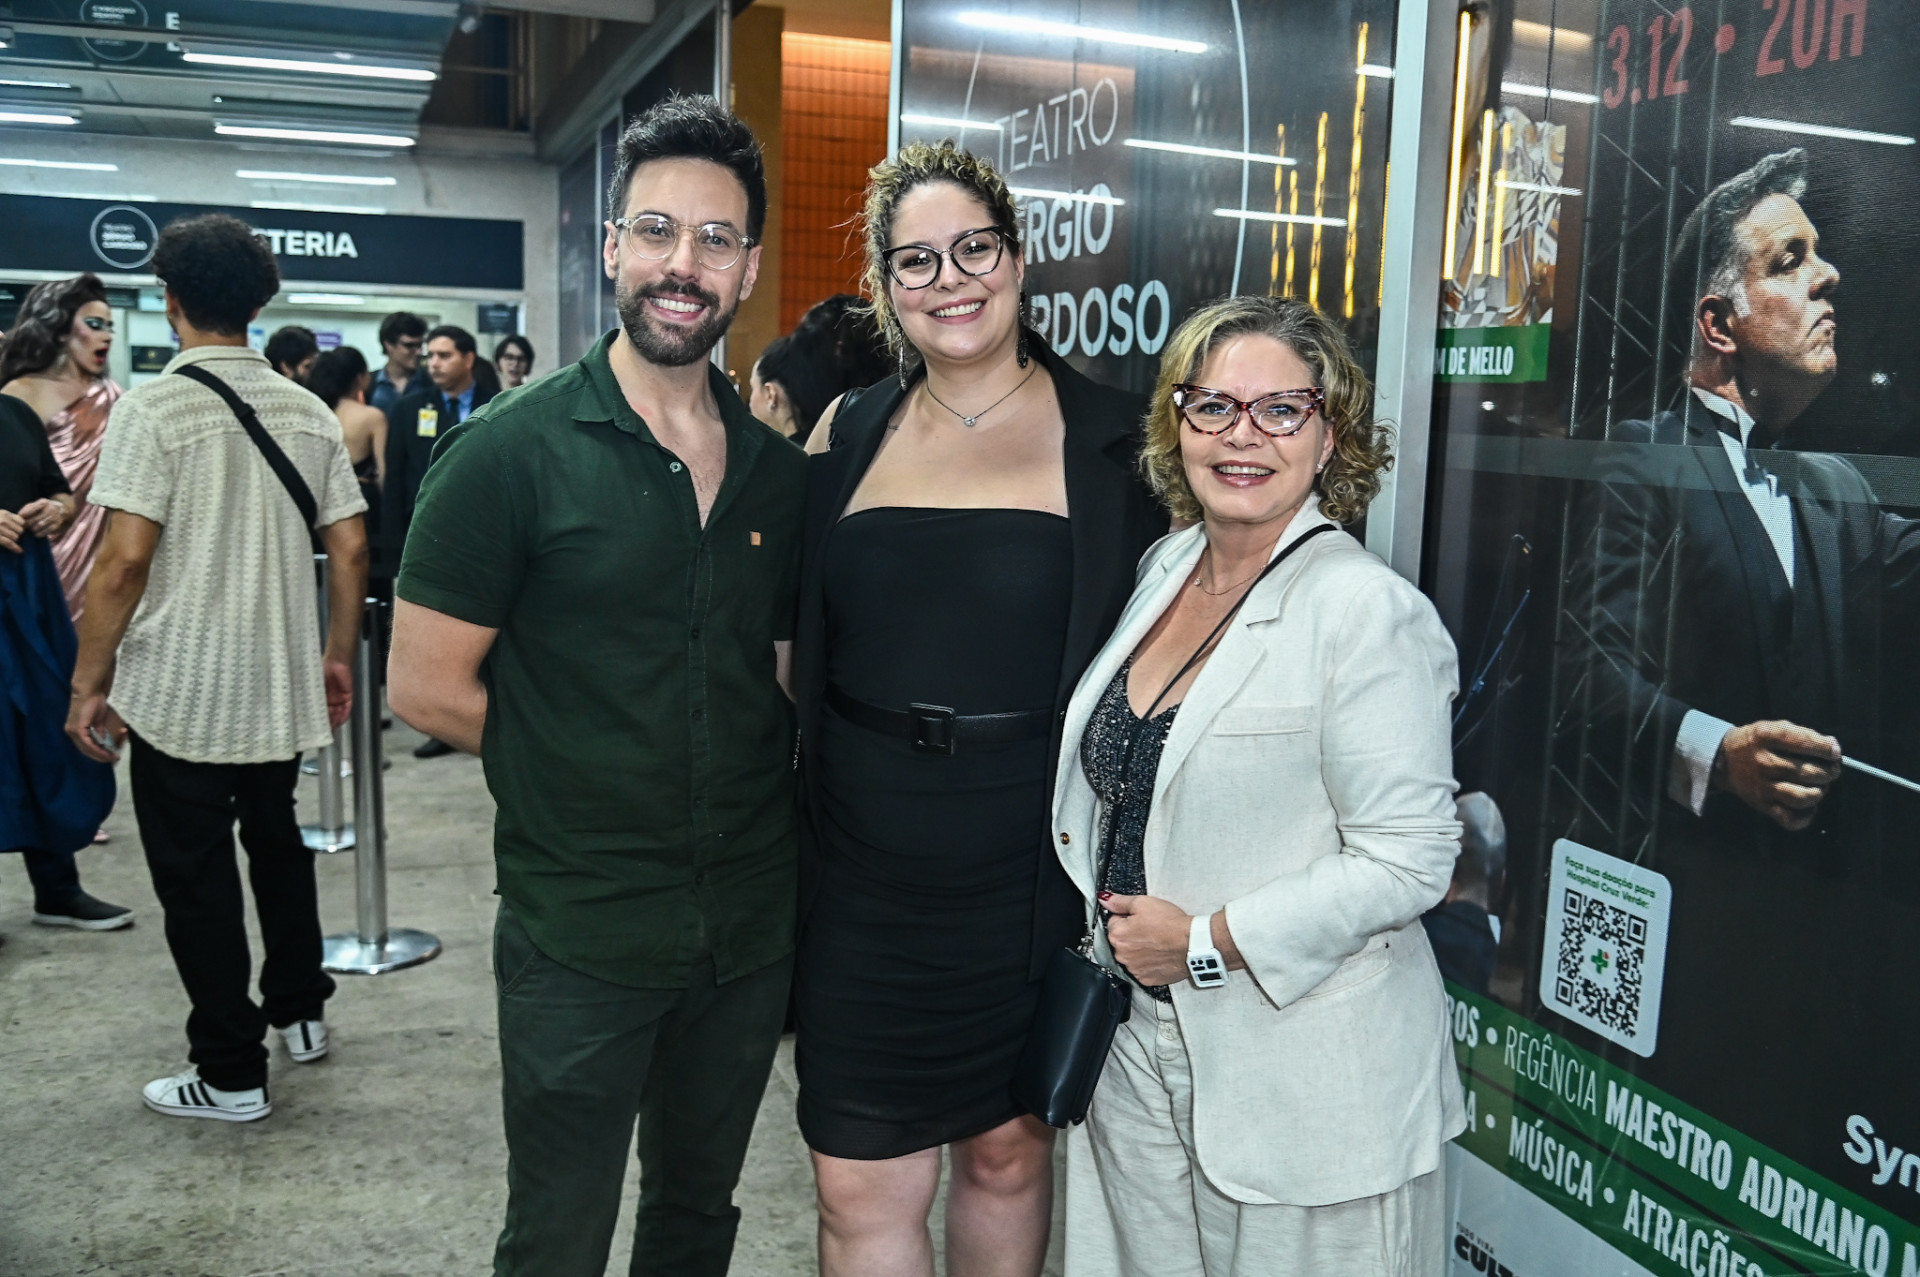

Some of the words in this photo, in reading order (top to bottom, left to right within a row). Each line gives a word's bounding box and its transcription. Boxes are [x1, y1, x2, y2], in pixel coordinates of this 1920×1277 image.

[1604, 7, 1693, 109] 3.12
[996, 77, 1118, 176] TEATRO
[252, 228, 358, 258] TERIA
[1448, 346, 1467, 375] DE
[1468, 345, 1514, 376] MELLO
[1586, 866, 1600, 877] sua
[1635, 885, 1656, 899] para
[1504, 1033, 1597, 1116] REGÊNCIA
[1605, 1079, 1732, 1190] MAESTRO
[1739, 1156, 1890, 1277] ADRIANO
[1509, 1115, 1593, 1207] MÚSICA
